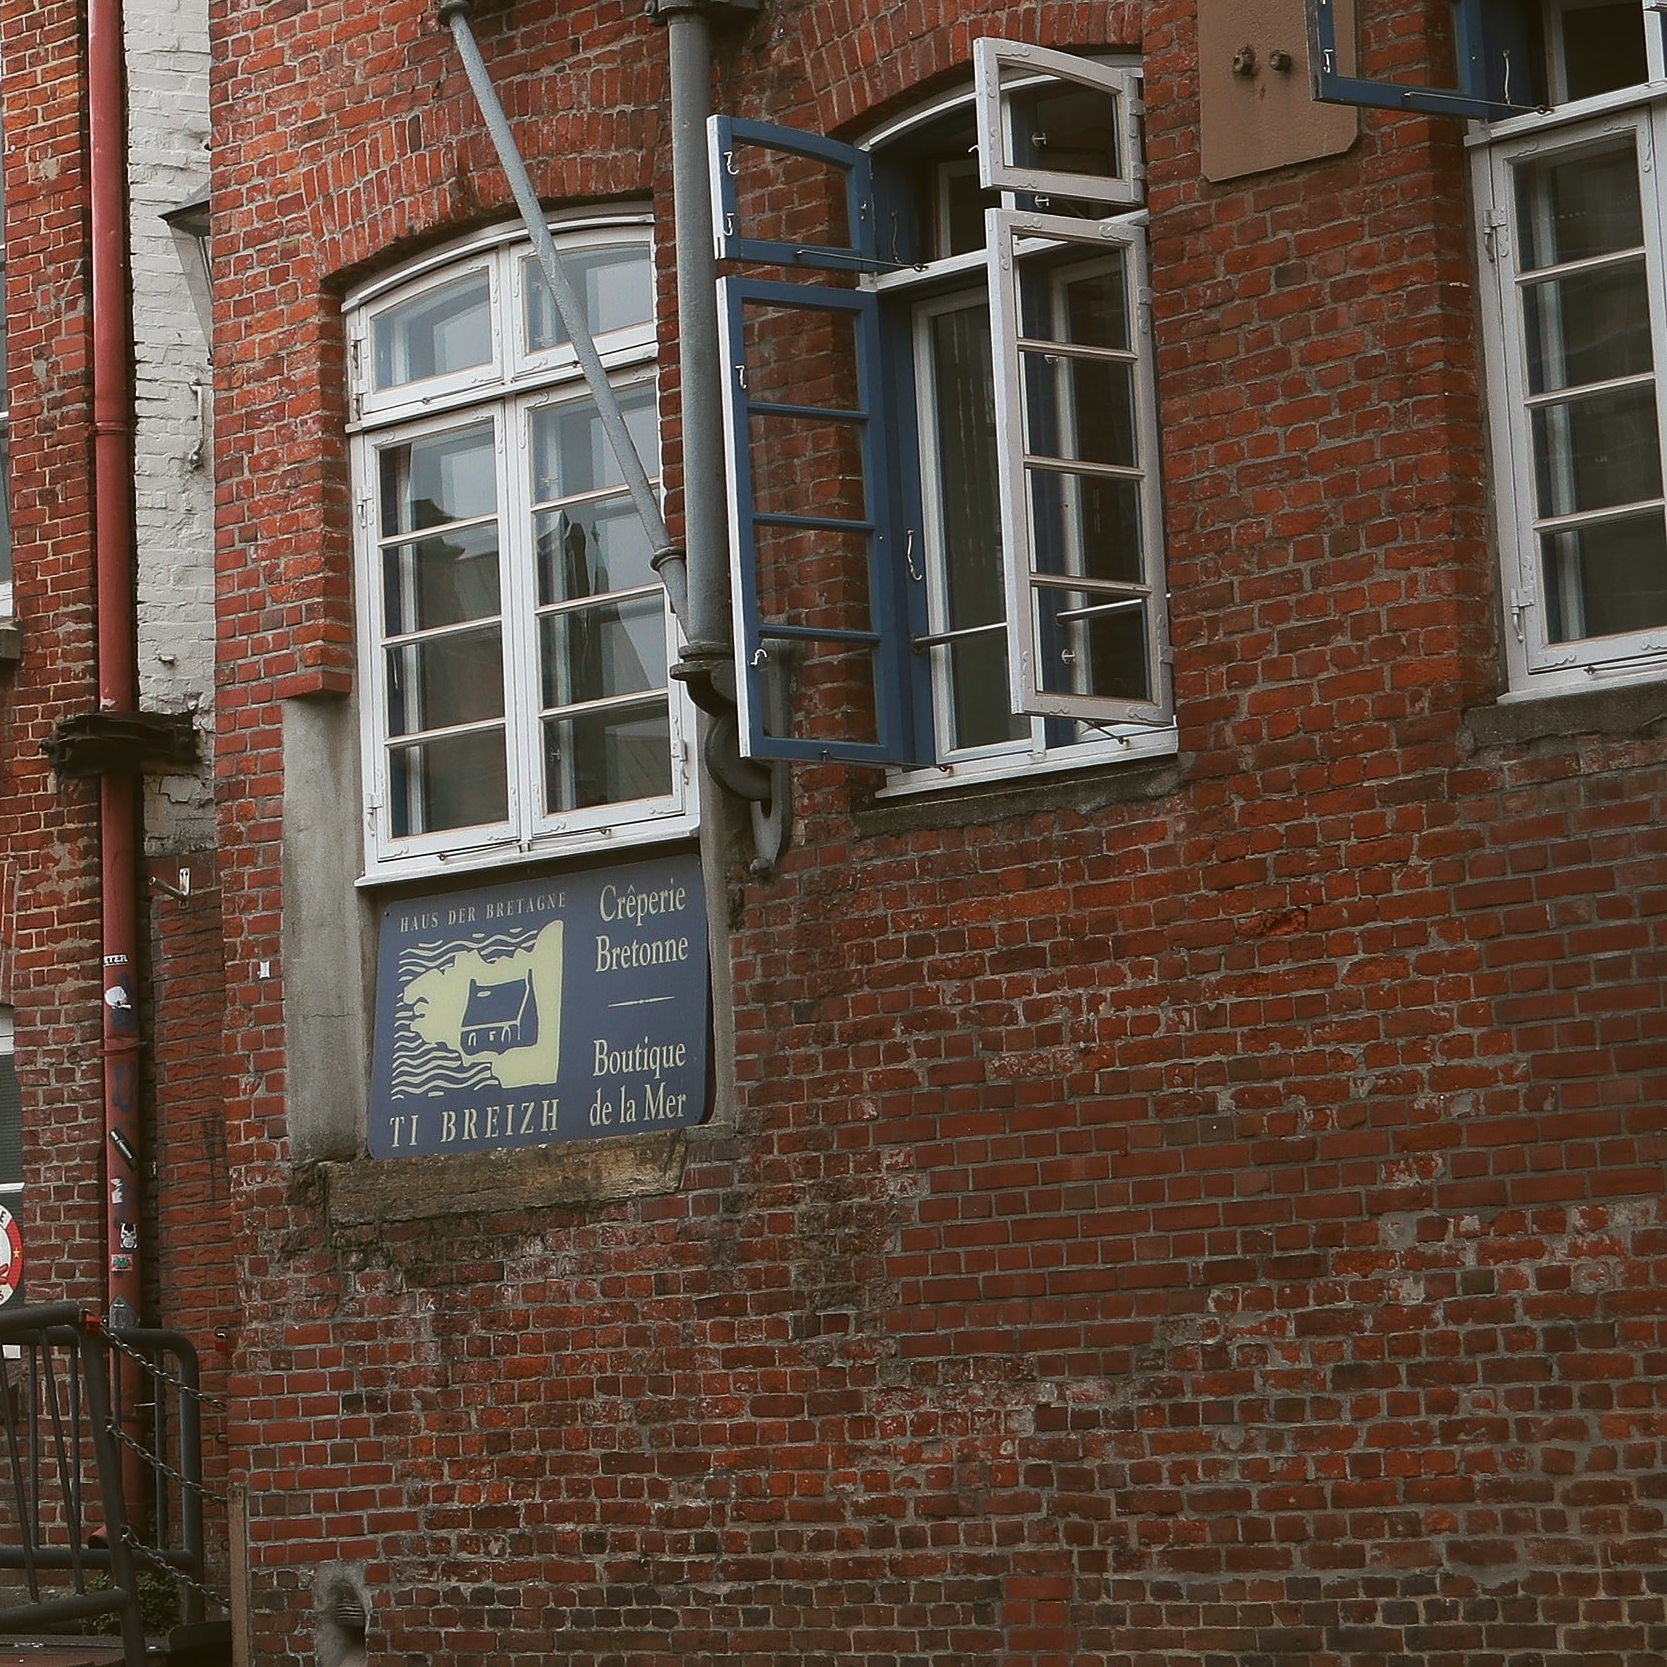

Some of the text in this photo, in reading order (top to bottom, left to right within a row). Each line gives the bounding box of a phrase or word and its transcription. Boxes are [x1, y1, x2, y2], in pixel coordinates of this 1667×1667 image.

[400, 891, 566, 933] HAUS DER BRETAGNE
[600, 877, 686, 926] Crêperie
[595, 935, 689, 972] Bretonne
[592, 1036, 686, 1079] Boutique
[390, 1099, 559, 1147] TI BREIZH
[590, 1082, 687, 1127] de la Mer
